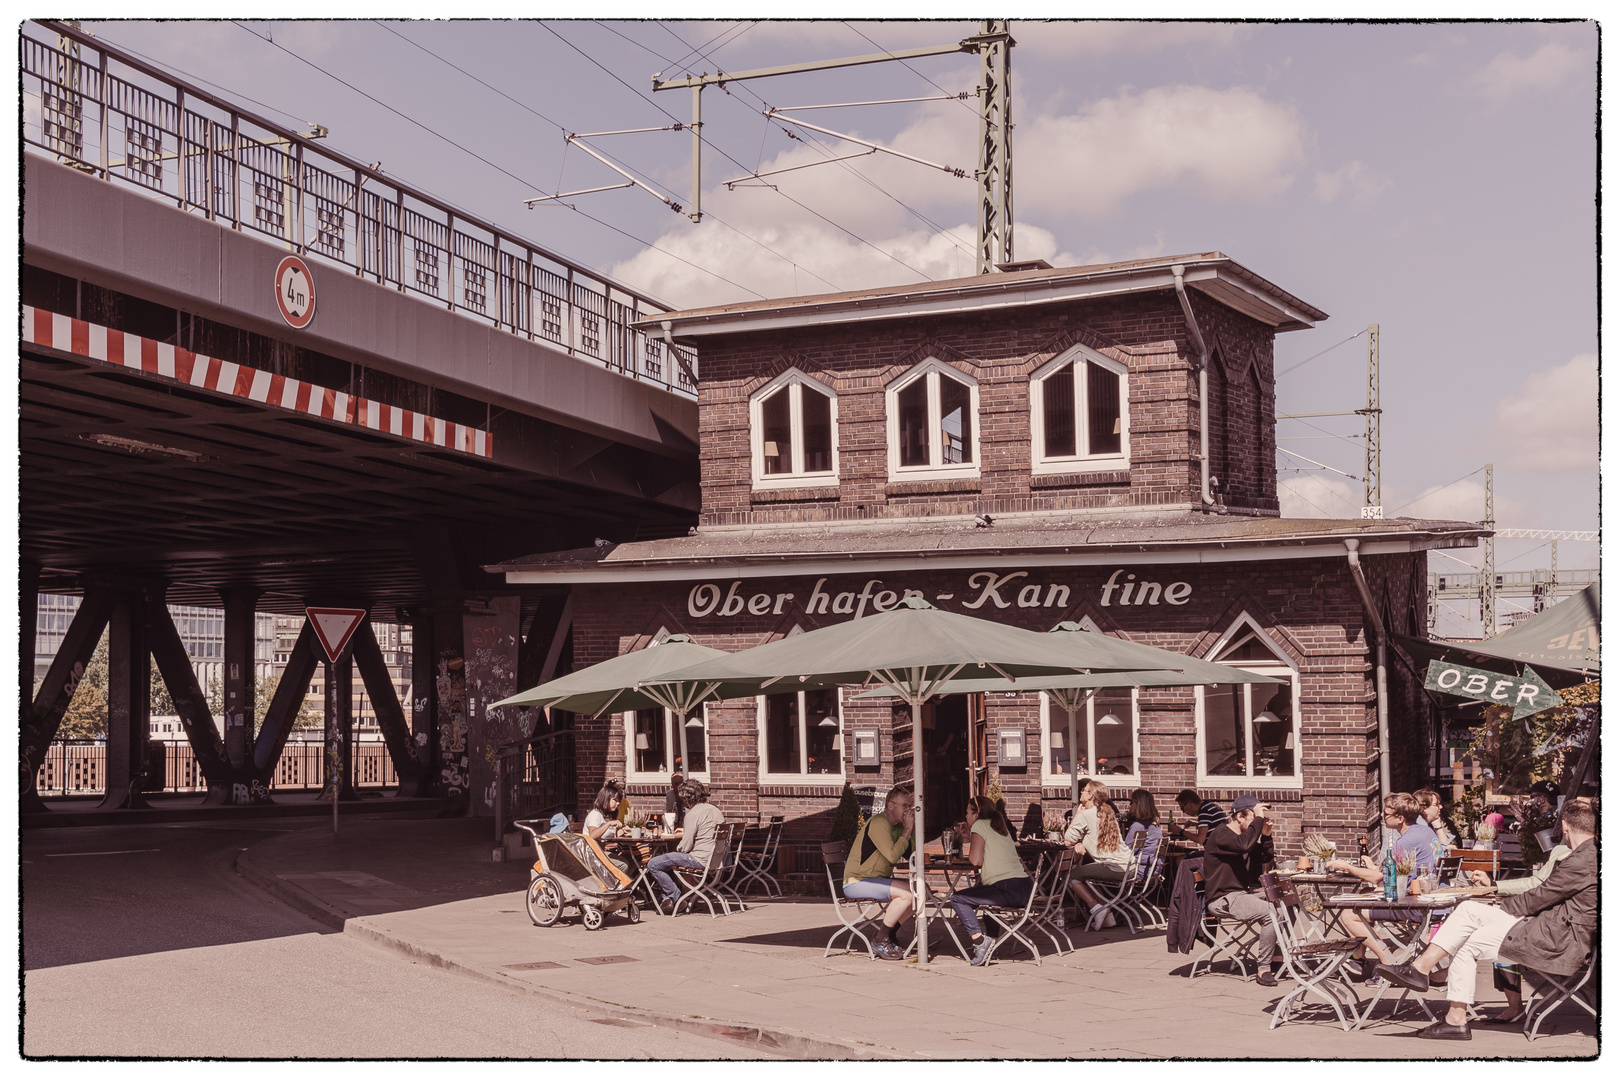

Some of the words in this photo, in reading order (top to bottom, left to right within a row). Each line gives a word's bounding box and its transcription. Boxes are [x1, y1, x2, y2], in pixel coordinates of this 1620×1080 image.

[1363, 508, 1382, 519] 354
[688, 581, 794, 618] Ober
[961, 571, 1071, 609] Kan
[1437, 668, 1540, 706] OBER
